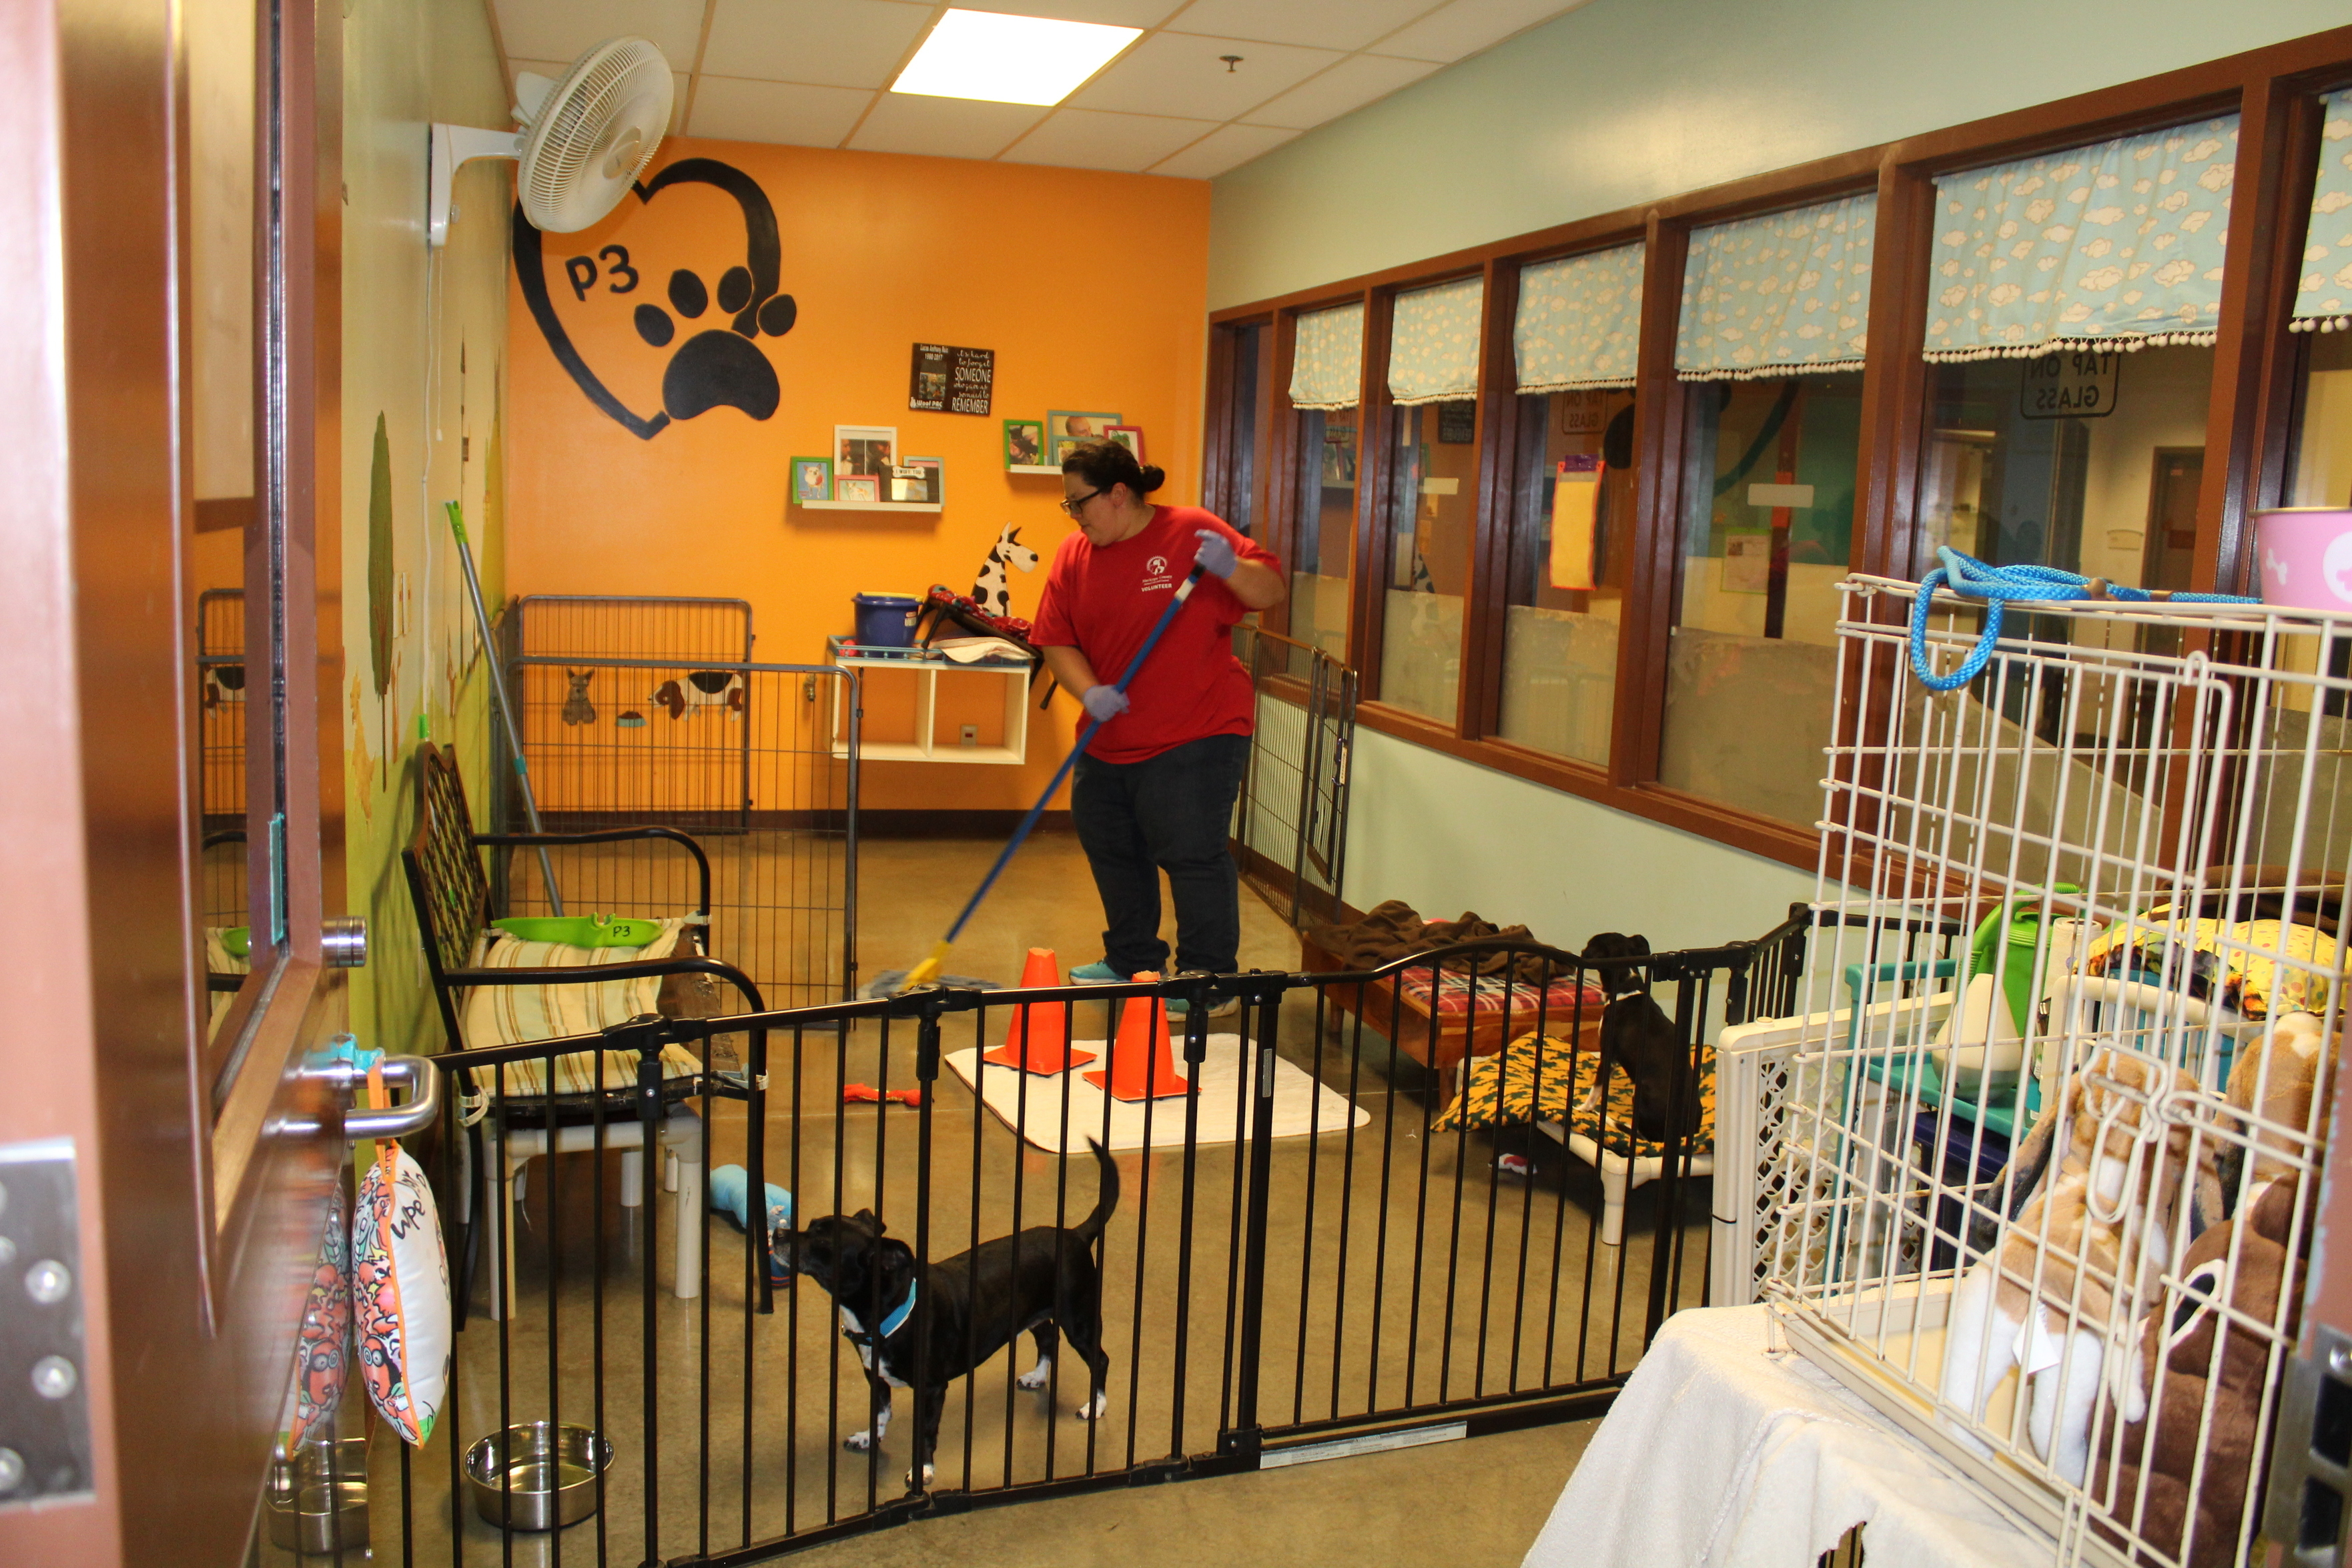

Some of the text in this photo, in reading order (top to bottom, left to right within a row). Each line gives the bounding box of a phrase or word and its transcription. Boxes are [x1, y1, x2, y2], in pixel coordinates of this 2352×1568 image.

[967, 358, 990, 369] forget
[955, 367, 991, 382] SOMEONE
[951, 397, 988, 414] REMEMBER
[1141, 583, 1172, 592] VOLUNTEER
[613, 925, 630, 937] P3
